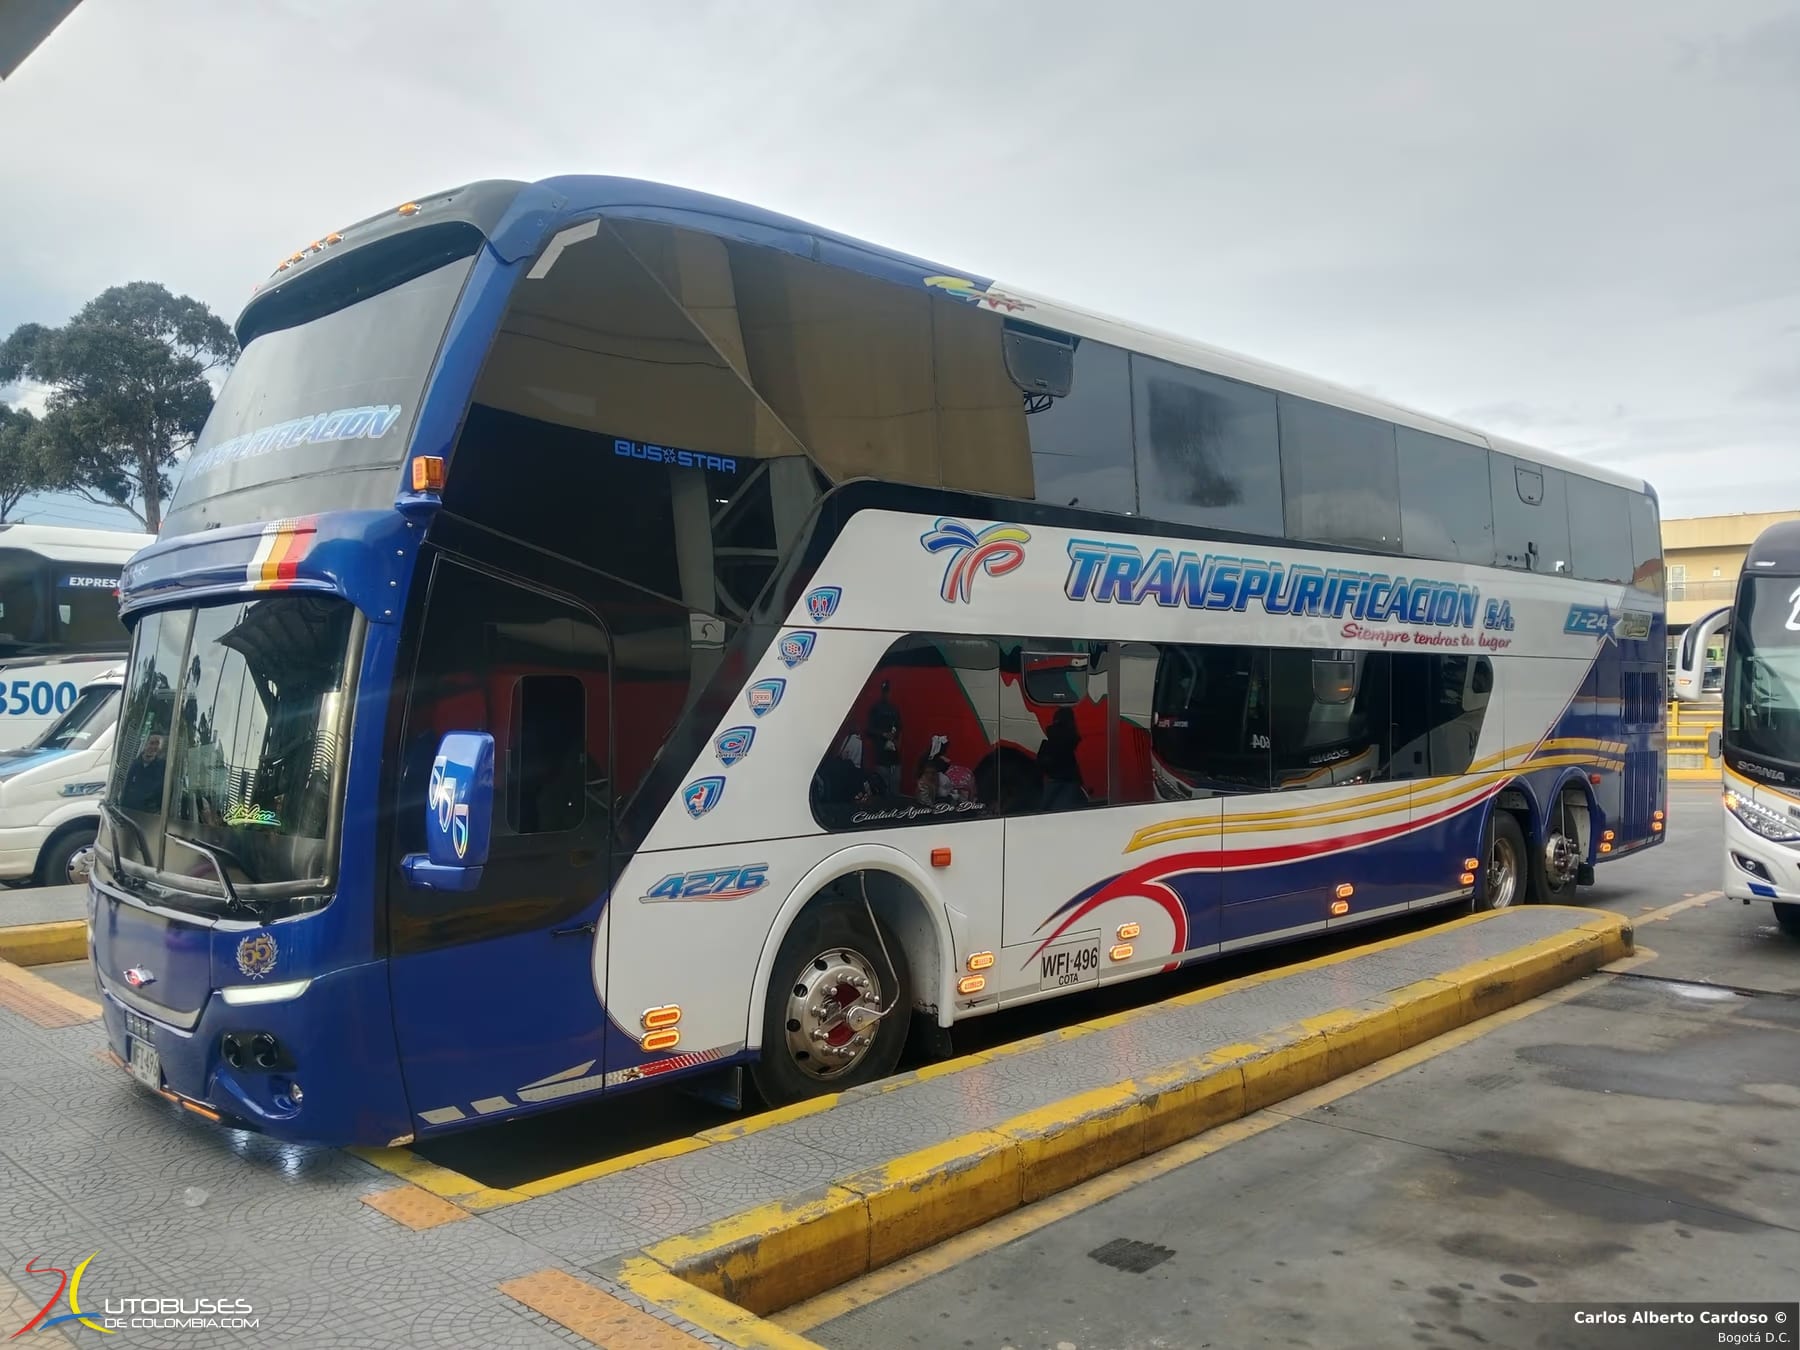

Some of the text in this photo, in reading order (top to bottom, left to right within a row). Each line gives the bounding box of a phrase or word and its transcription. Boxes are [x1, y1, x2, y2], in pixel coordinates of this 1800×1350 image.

[614, 440, 736, 474] BUS STAR
[1064, 538, 1479, 629] TRANSPURIFICACION
[1570, 610, 1609, 630] 7-24
[1341, 622, 1512, 651] Siempre tendras tu lugar
[1737, 760, 1785, 781] SCANIA
[851, 800, 985, 823] Ciudad Agua De Dios
[647, 862, 769, 899] 4276
[243, 937, 271, 966] 55
[1042, 946, 1098, 978] WFI-496
[1058, 973, 1079, 985] COTA
